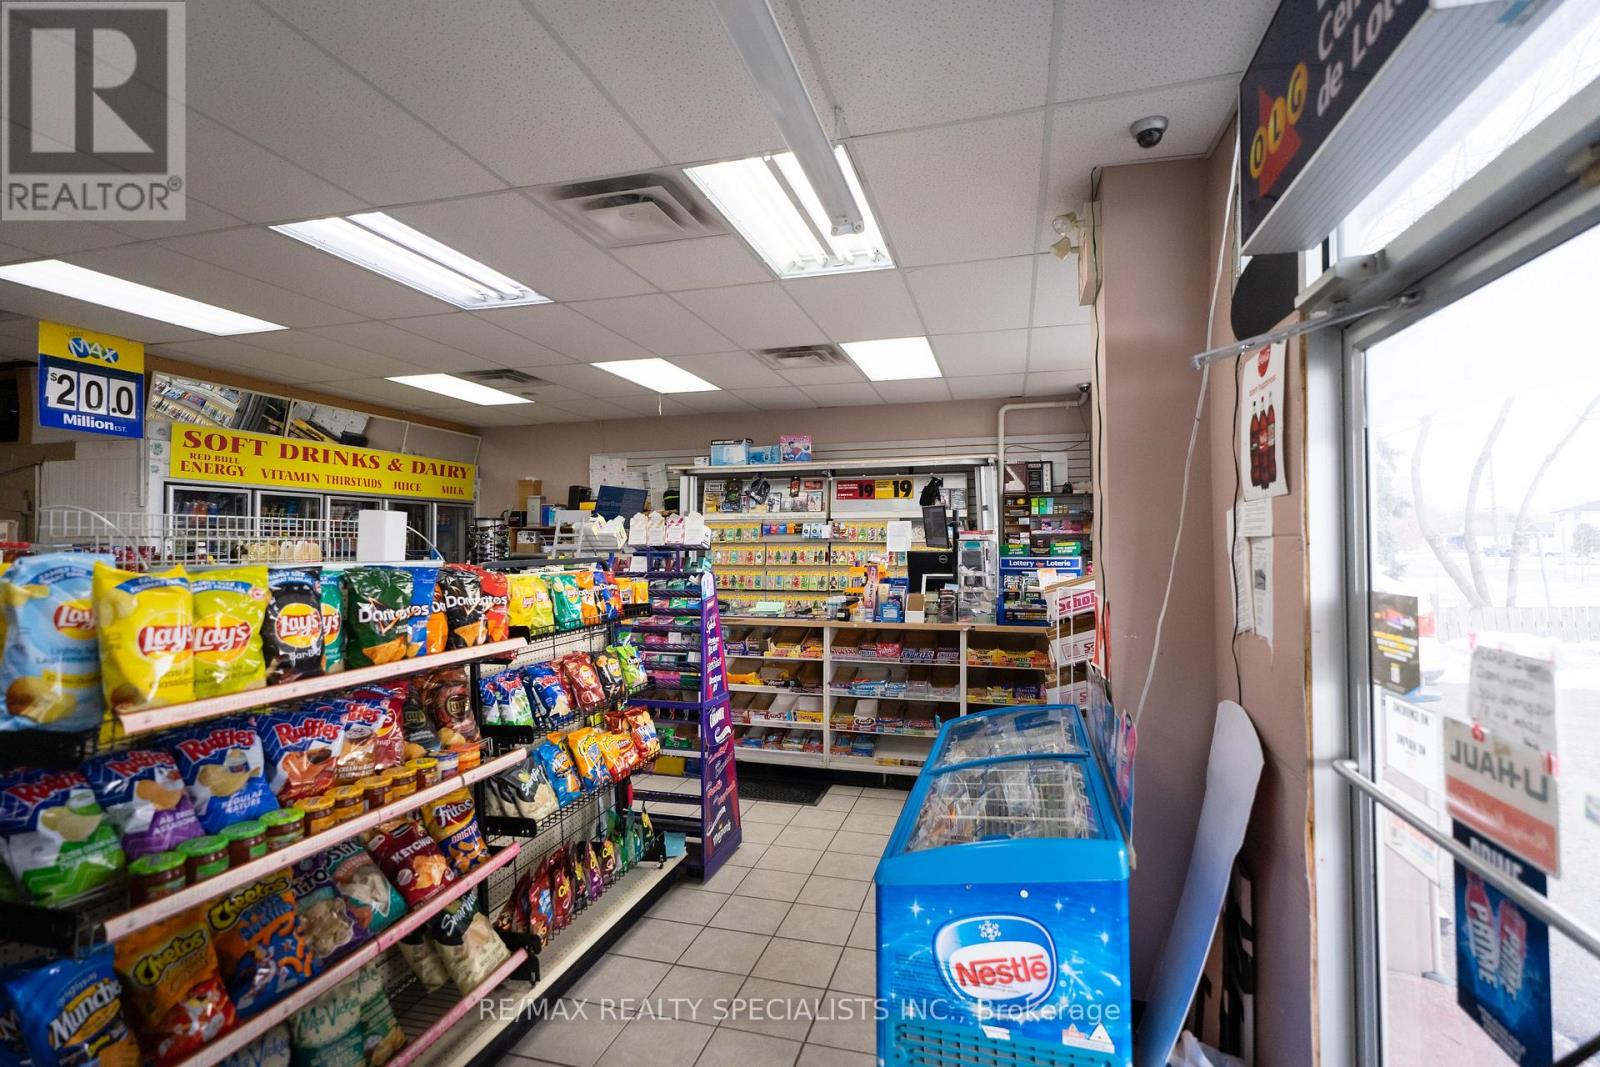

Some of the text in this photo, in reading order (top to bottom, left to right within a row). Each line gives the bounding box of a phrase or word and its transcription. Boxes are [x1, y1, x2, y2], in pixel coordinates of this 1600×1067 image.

[1317, 60, 1344, 117] de
[1249, 62, 1309, 179] OLG
[67, 336, 120, 364] MAX
[63, 413, 114, 431] Million
[182, 430, 471, 479] SOFT DRINKS & DAIRY
[189, 452, 240, 464] RED BULL
[180, 460, 465, 495] ENERGY VITAMIN THIRSTAIDS JUICE MILK
[858, 480, 874, 498] 19
[892, 480, 913, 498] 19
[1009, 560, 1035, 569] Lottery
[1046, 560, 1071, 568] Loterie
[176, 728, 257, 765] Ruffles
[273, 717, 344, 749] Ruffles
[432, 798, 474, 828] Fritos
[209, 878, 289, 931] Cheetos
[133, 929, 208, 985] Cheetos
[49, 979, 123, 1052] Munchie
